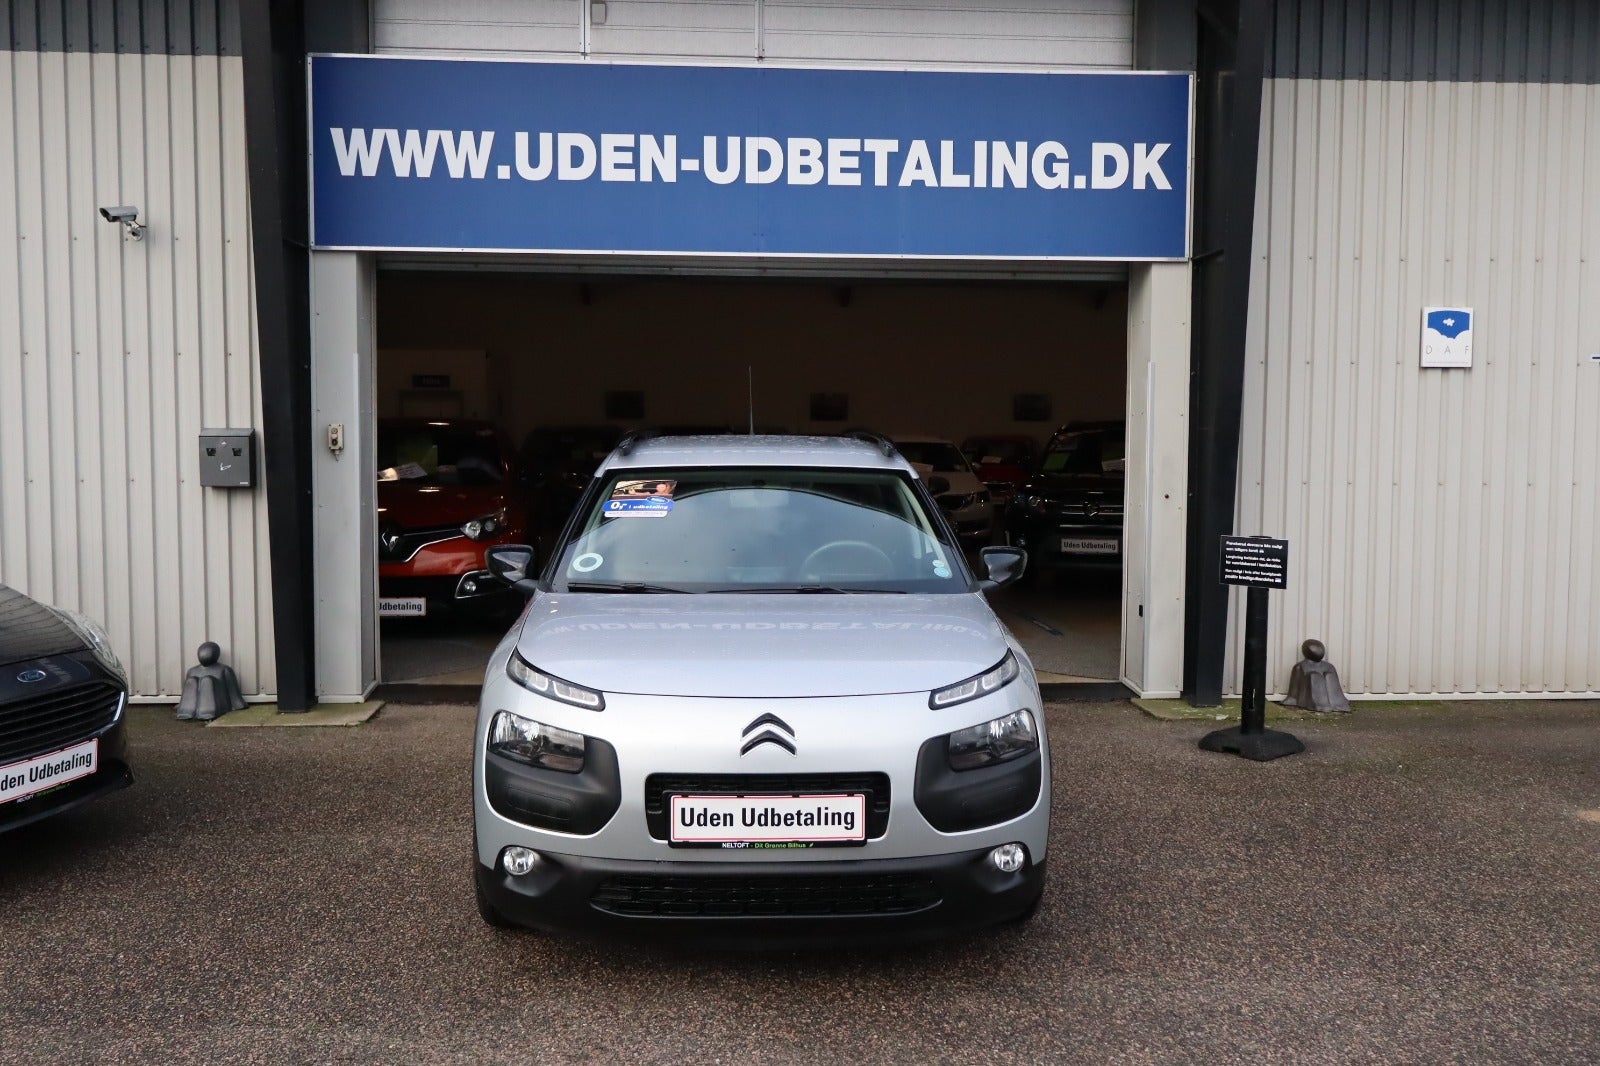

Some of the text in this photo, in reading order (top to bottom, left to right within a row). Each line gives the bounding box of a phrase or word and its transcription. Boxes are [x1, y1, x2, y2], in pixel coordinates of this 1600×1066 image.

[329, 126, 1172, 192] WWW.UDEN-UDBETALING.DK
[1081, 541, 1116, 551] Udbetaling
[0, 752, 92, 791] den Udbetaling
[681, 806, 855, 831] Uden Udbetaling
